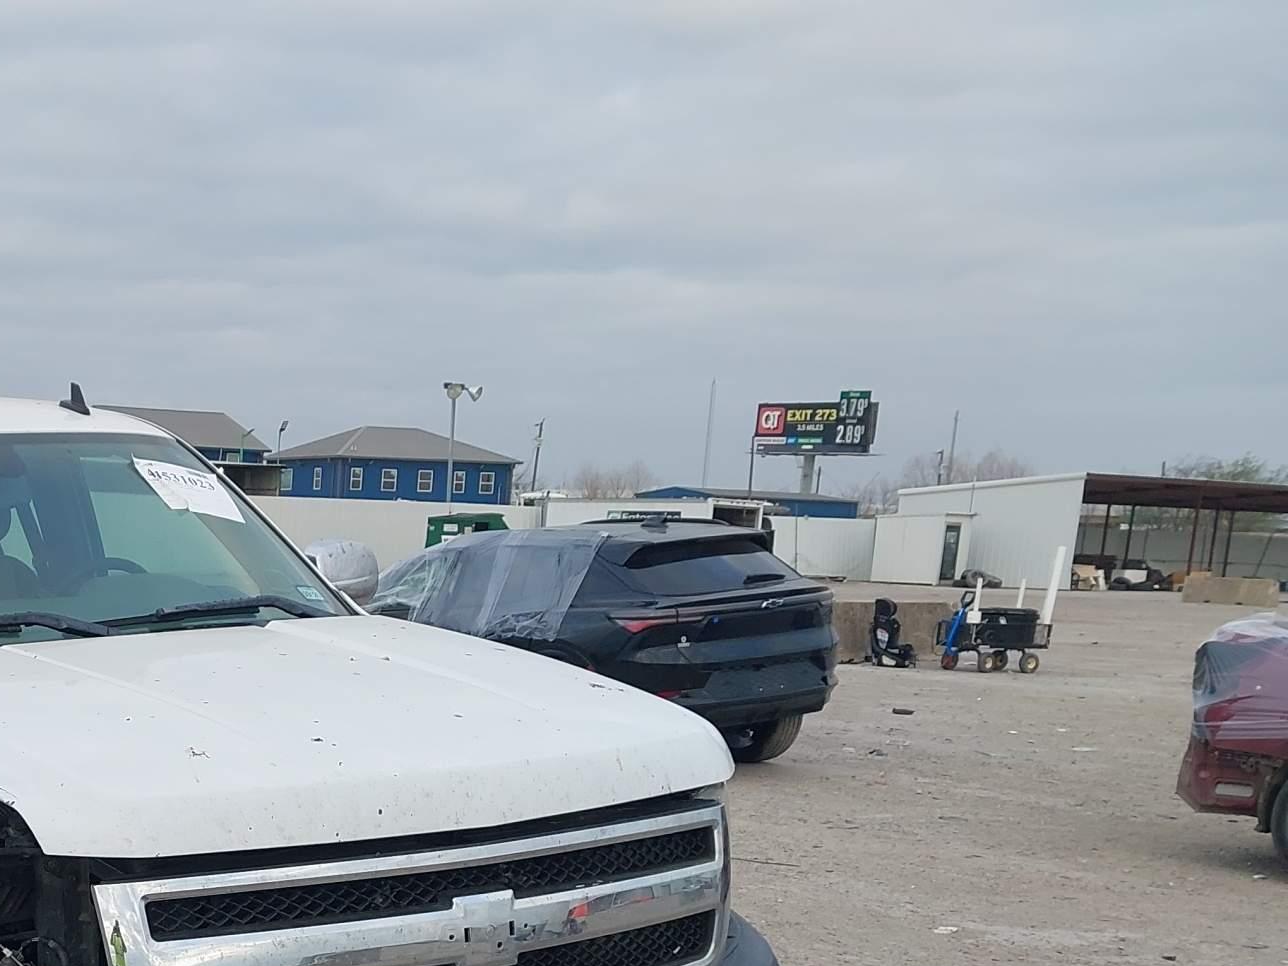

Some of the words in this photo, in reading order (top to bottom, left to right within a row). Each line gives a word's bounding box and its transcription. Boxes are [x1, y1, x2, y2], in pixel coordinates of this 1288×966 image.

[762, 411, 781, 429] QT
[786, 409, 813, 421] EXIT
[814, 408, 838, 421] 273
